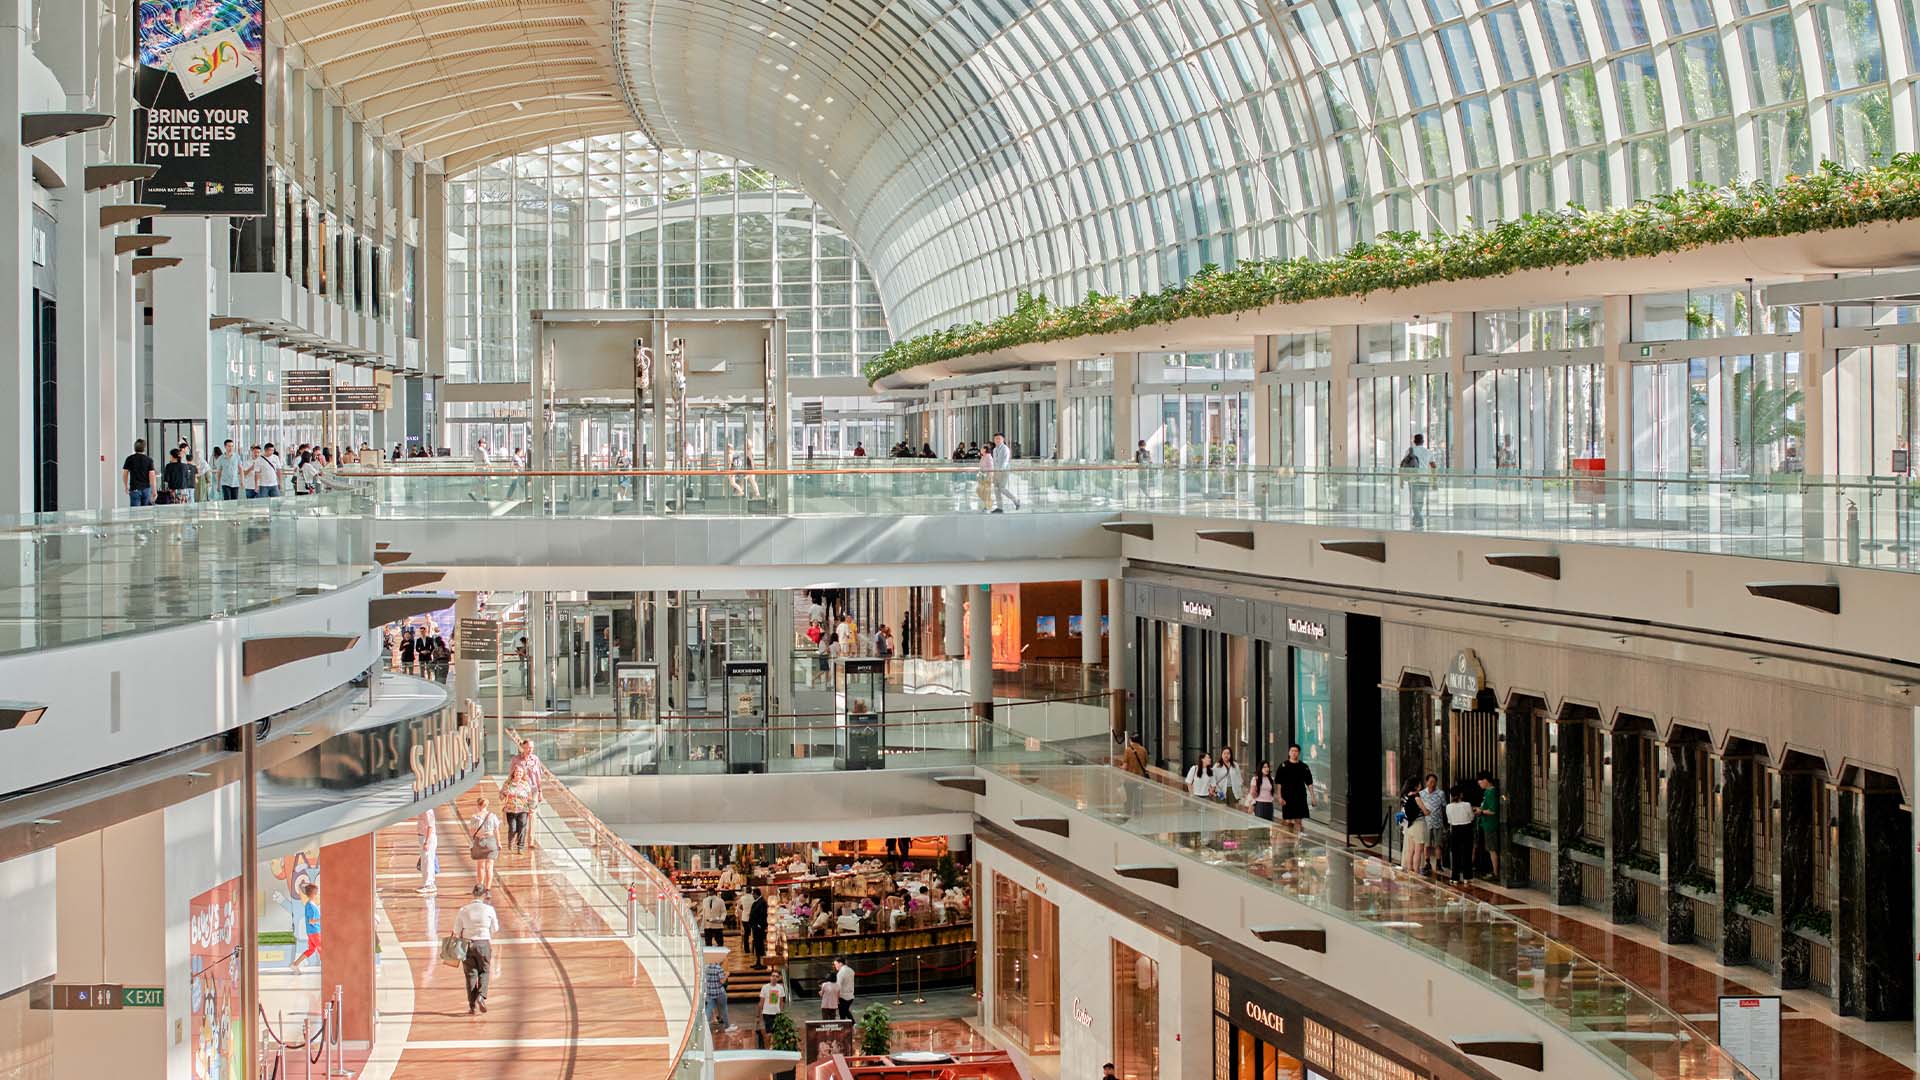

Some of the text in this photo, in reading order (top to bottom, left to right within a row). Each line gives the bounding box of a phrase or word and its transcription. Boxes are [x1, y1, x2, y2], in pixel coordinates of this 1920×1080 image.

[148, 109, 249, 124] BRING YOUR
[148, 126, 236, 141] SKETCHES
[148, 142, 210, 157] TO LIFE
[559, 614, 568, 622] B1
[136, 990, 162, 1004] EXIT
[1073, 997, 1094, 1027] Cartier
[1246, 1001, 1285, 1034] COACH
